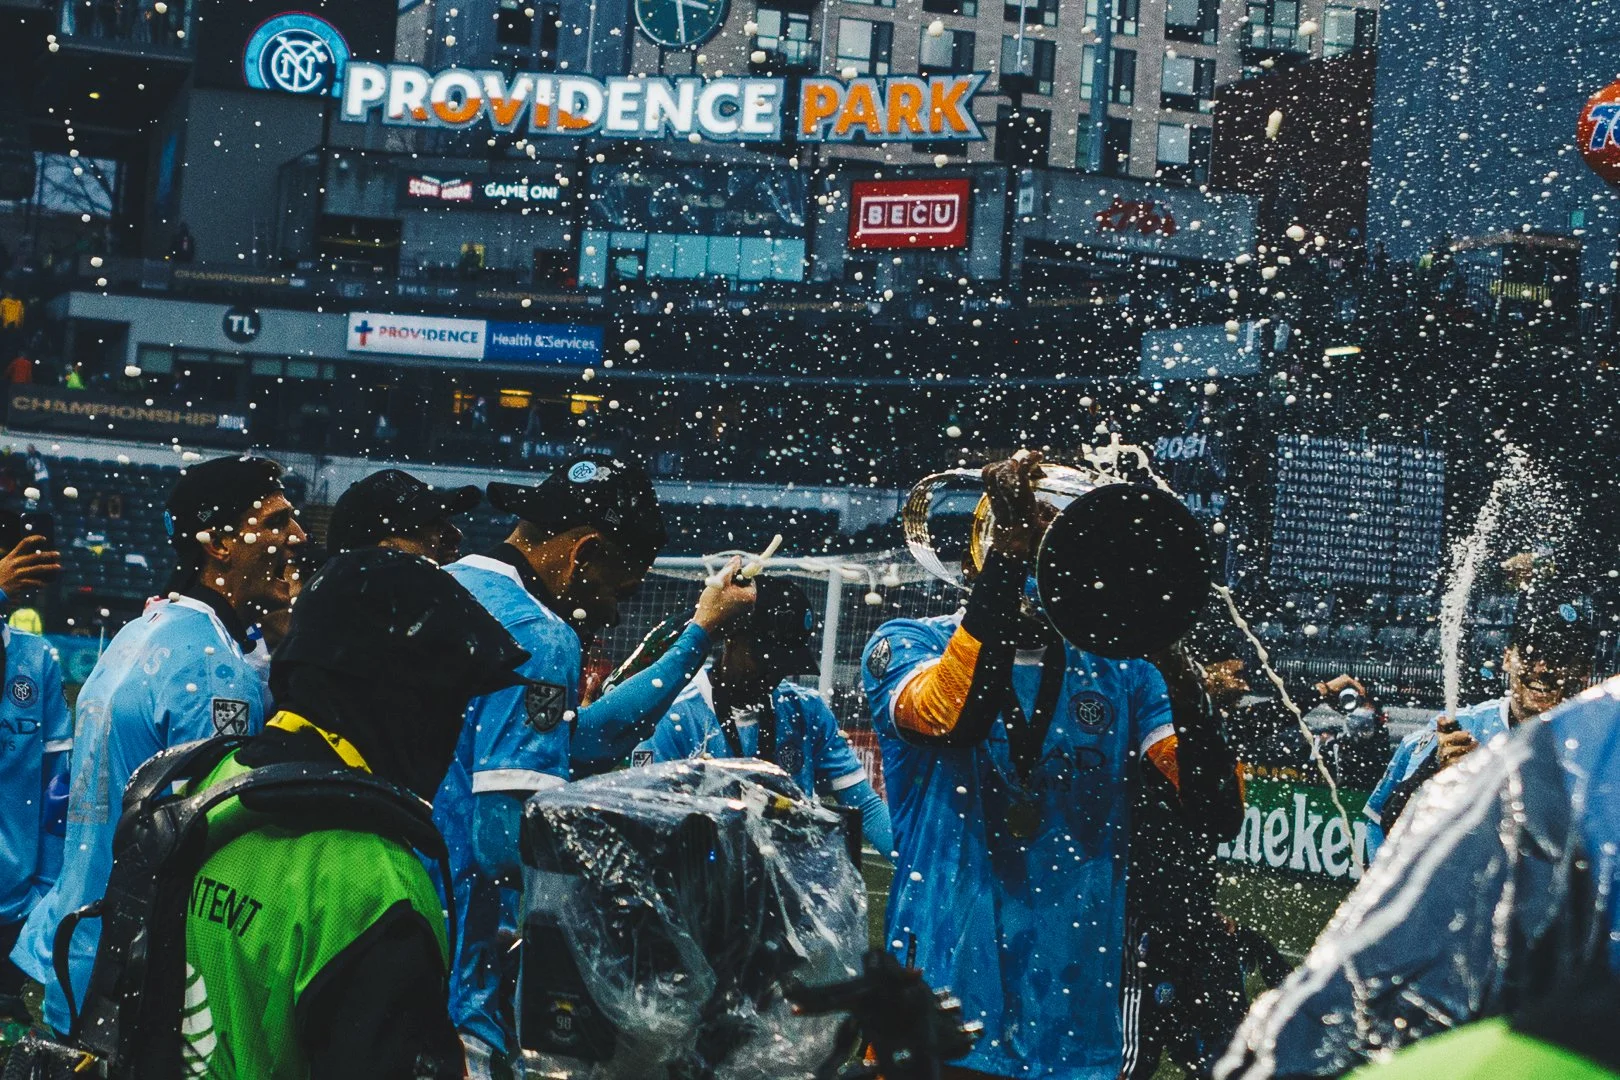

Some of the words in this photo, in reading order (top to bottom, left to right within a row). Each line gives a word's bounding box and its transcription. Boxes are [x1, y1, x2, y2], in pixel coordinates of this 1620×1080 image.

[345, 65, 779, 133] PROVIDENCE
[801, 79, 972, 136] PARK
[484, 183, 528, 198] GAME
[530, 185, 558, 200] ON!
[868, 203, 951, 225] BECU
[228, 315, 255, 334] TL
[378, 325, 479, 344] PROVIDENCE
[492, 332, 531, 347] Health
[546, 335, 597, 351] Services
[216, 702, 238, 713] MLS
